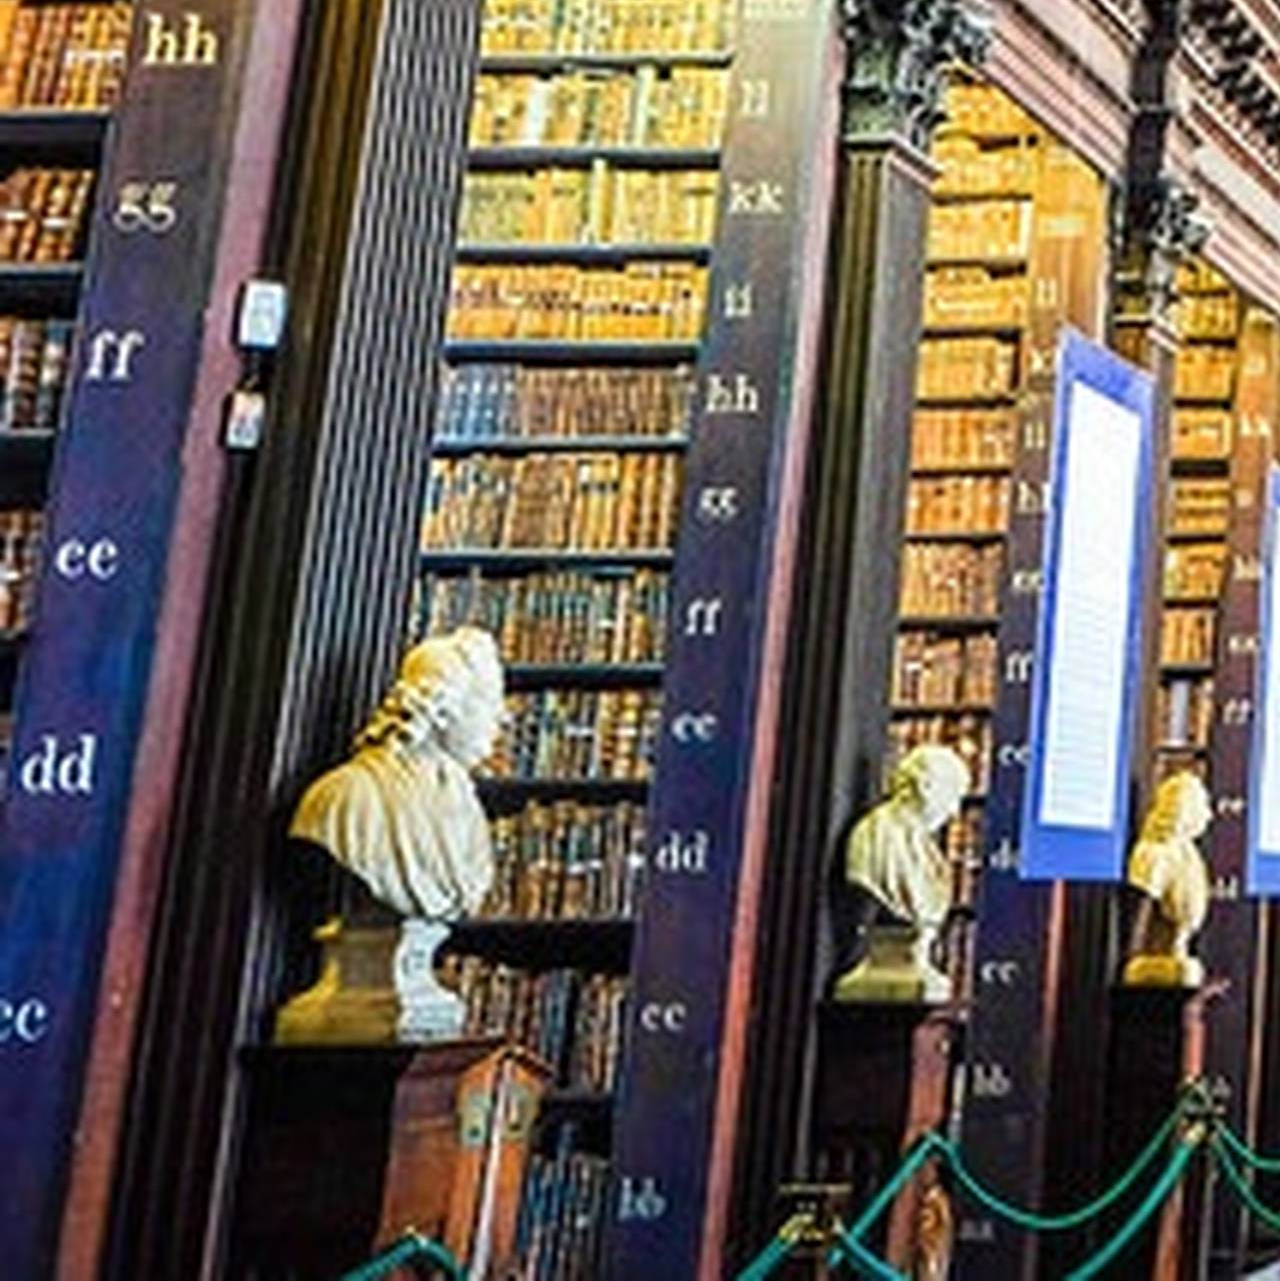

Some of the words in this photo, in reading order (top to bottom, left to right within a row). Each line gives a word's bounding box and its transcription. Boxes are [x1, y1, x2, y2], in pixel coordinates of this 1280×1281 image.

[142, 12, 217, 66] hh
[113, 183, 176, 230] gg
[728, 181, 783, 214] kk
[86, 330, 144, 379] ff
[705, 374, 758, 414] hh
[55, 539, 118, 578] ee
[685, 598, 721, 635] ff
[21, 734, 95, 793] dd
[655, 831, 708, 871] dd
